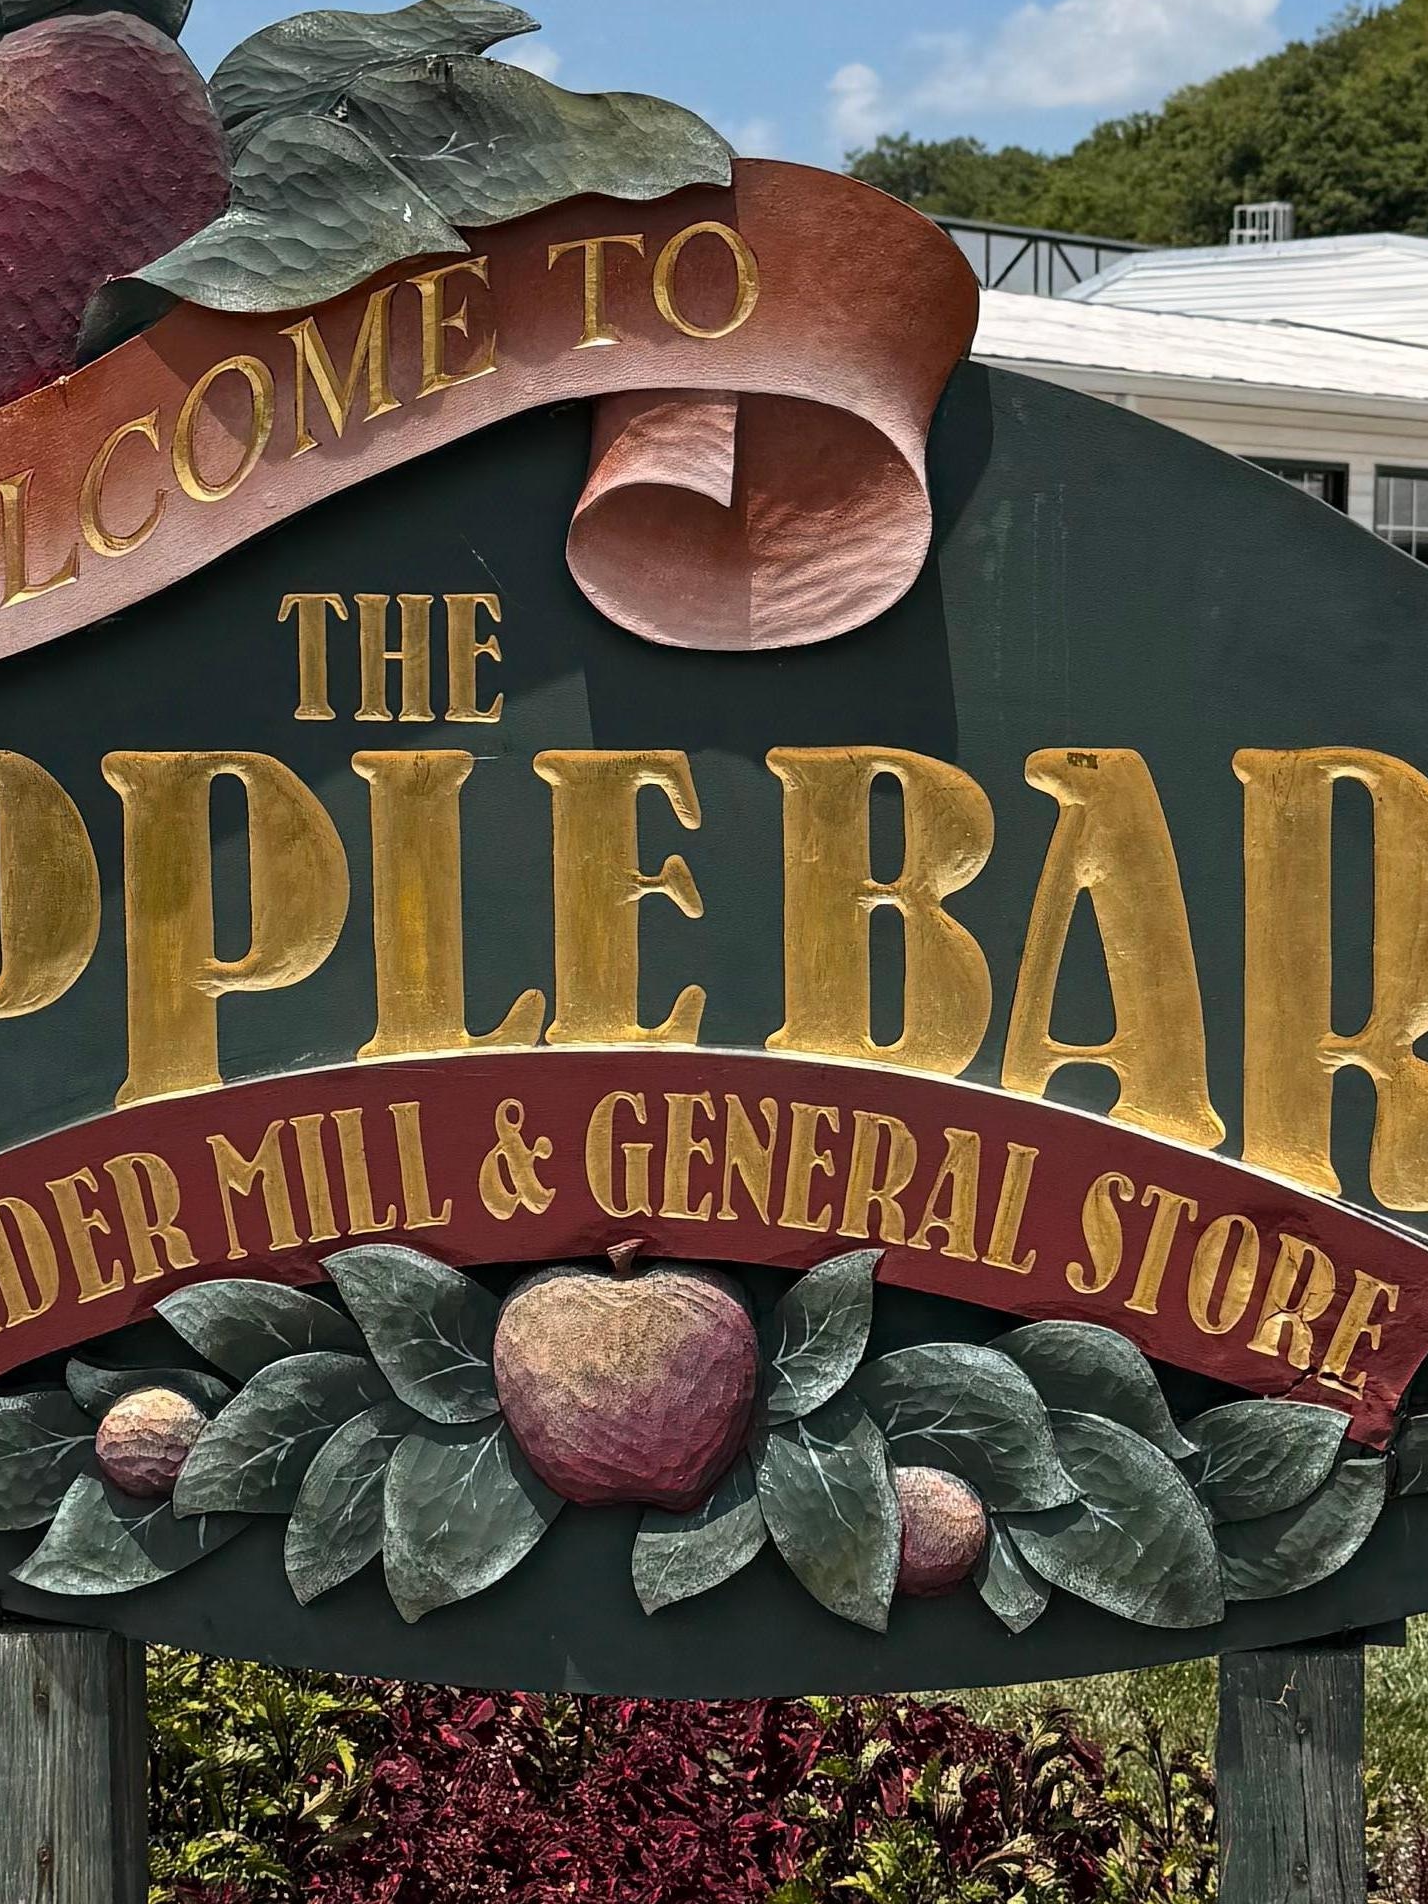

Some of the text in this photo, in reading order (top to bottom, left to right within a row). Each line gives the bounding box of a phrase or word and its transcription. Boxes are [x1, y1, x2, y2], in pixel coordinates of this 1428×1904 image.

[549, 220, 759, 348] TO
[278, 593, 505, 723] THE
[206, 1100, 454, 1264] MILL
[478, 1099, 556, 1220] &
[585, 1091, 1040, 1274] GENERAL
[1067, 1171, 1401, 1399] STORE
